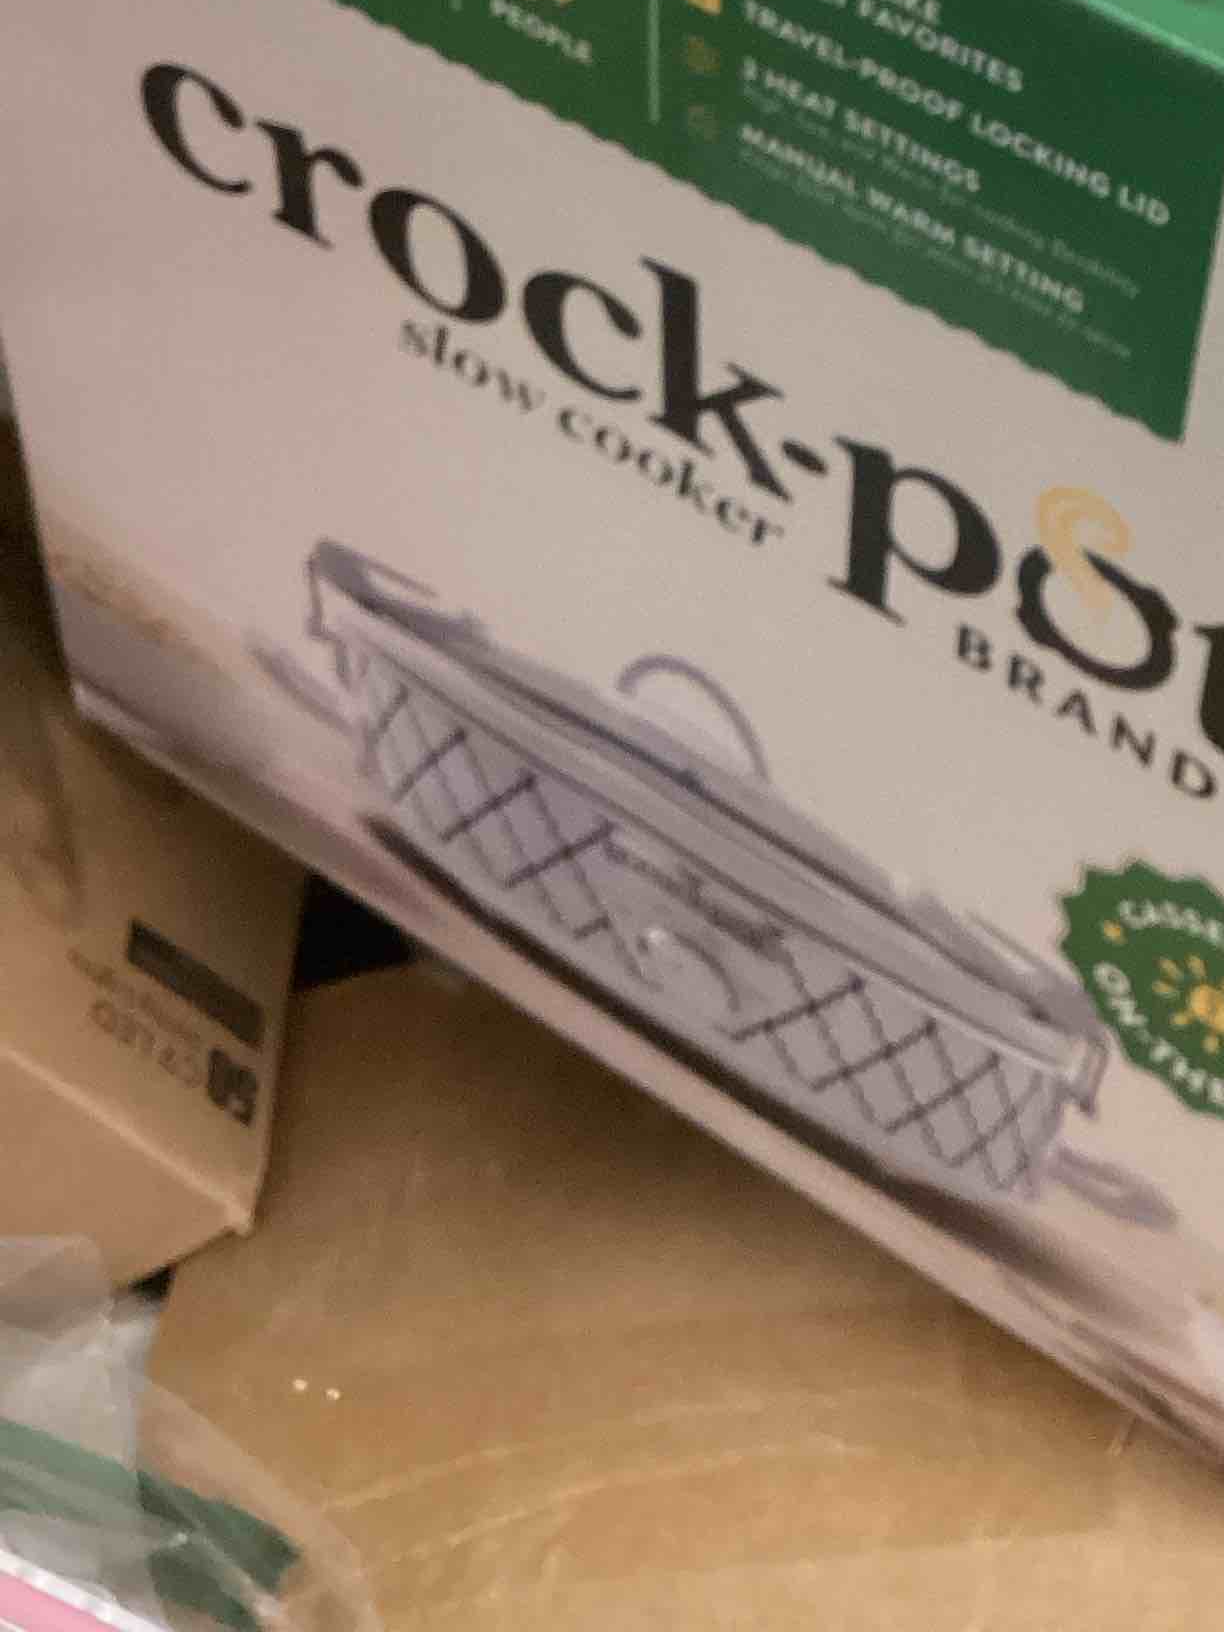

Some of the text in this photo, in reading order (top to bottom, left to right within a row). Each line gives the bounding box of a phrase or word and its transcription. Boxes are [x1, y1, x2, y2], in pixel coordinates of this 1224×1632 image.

[739, 123, 1085, 313] MANUAL WARM SETTING
[764, 67, 838, 121] HEAT
[843, 107, 981, 194] SETTINGS
[969, 112, 1111, 199] LOCKING
[1117, 183, 1171, 226] LID
[401, 319, 785, 546] slow cooker
[956, 623, 1218, 800] BRAND
